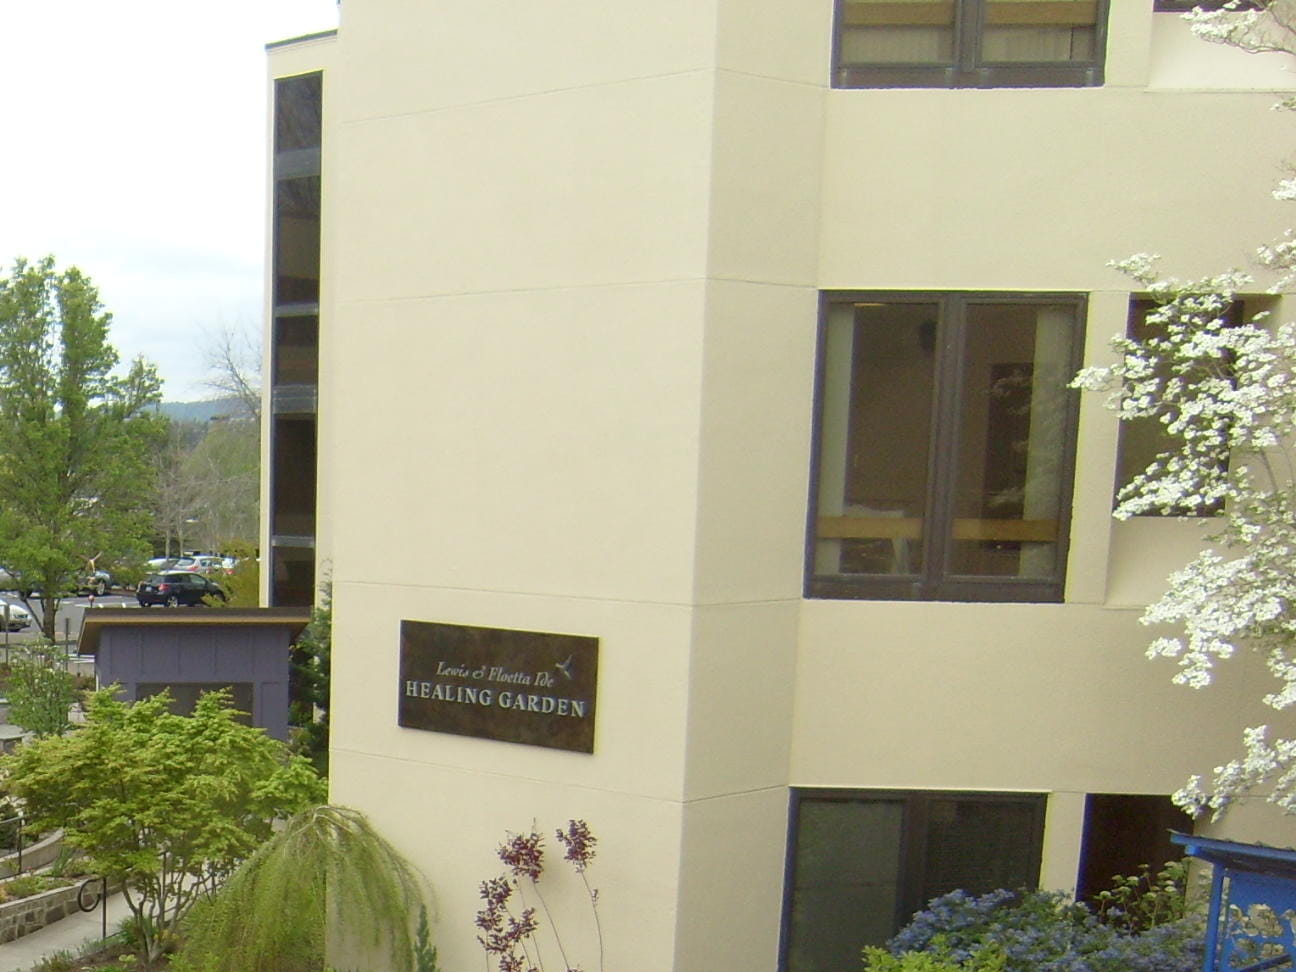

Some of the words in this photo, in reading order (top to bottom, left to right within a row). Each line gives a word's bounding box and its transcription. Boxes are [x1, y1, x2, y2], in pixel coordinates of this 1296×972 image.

[436, 661, 469, 678] Lewis
[473, 665, 486, 679] &
[489, 666, 531, 686] Floetta
[534, 671, 555, 688] Ide
[406, 680, 492, 706] HEALING
[498, 691, 585, 718] GARDEN
